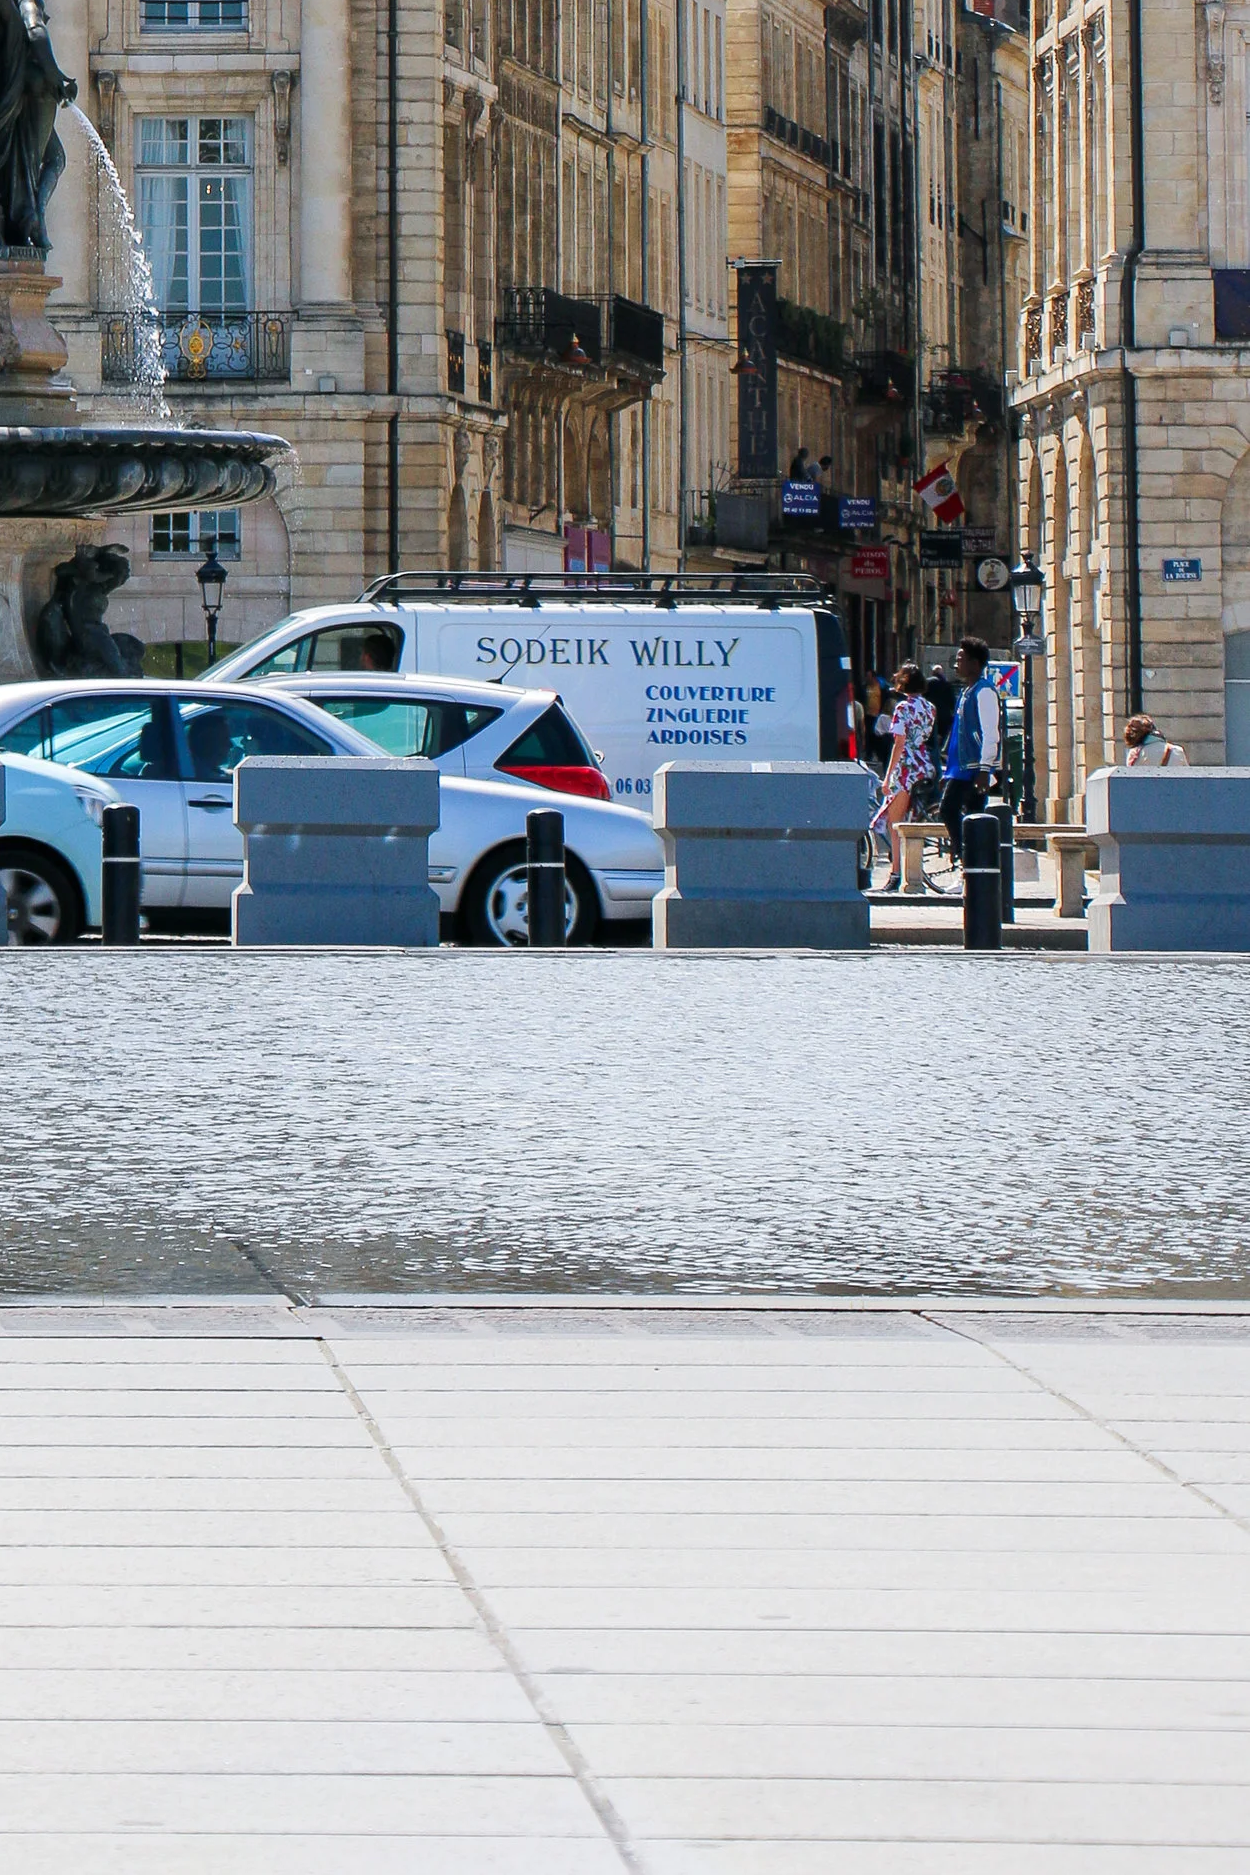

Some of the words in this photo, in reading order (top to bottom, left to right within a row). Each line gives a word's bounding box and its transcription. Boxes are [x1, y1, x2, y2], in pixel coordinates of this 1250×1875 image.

[747, 292, 768, 456] ACANTHE
[789, 483, 814, 491] VENDU
[476, 636, 610, 666] SODEIK
[629, 635, 740, 667] WILLY
[645, 684, 777, 703] COUVERTURE
[645, 707, 750, 725] ZINGUERIE
[645, 729, 748, 746] ARDOISES
[616, 777, 632, 794] 06
[635, 778, 651, 794] 03
